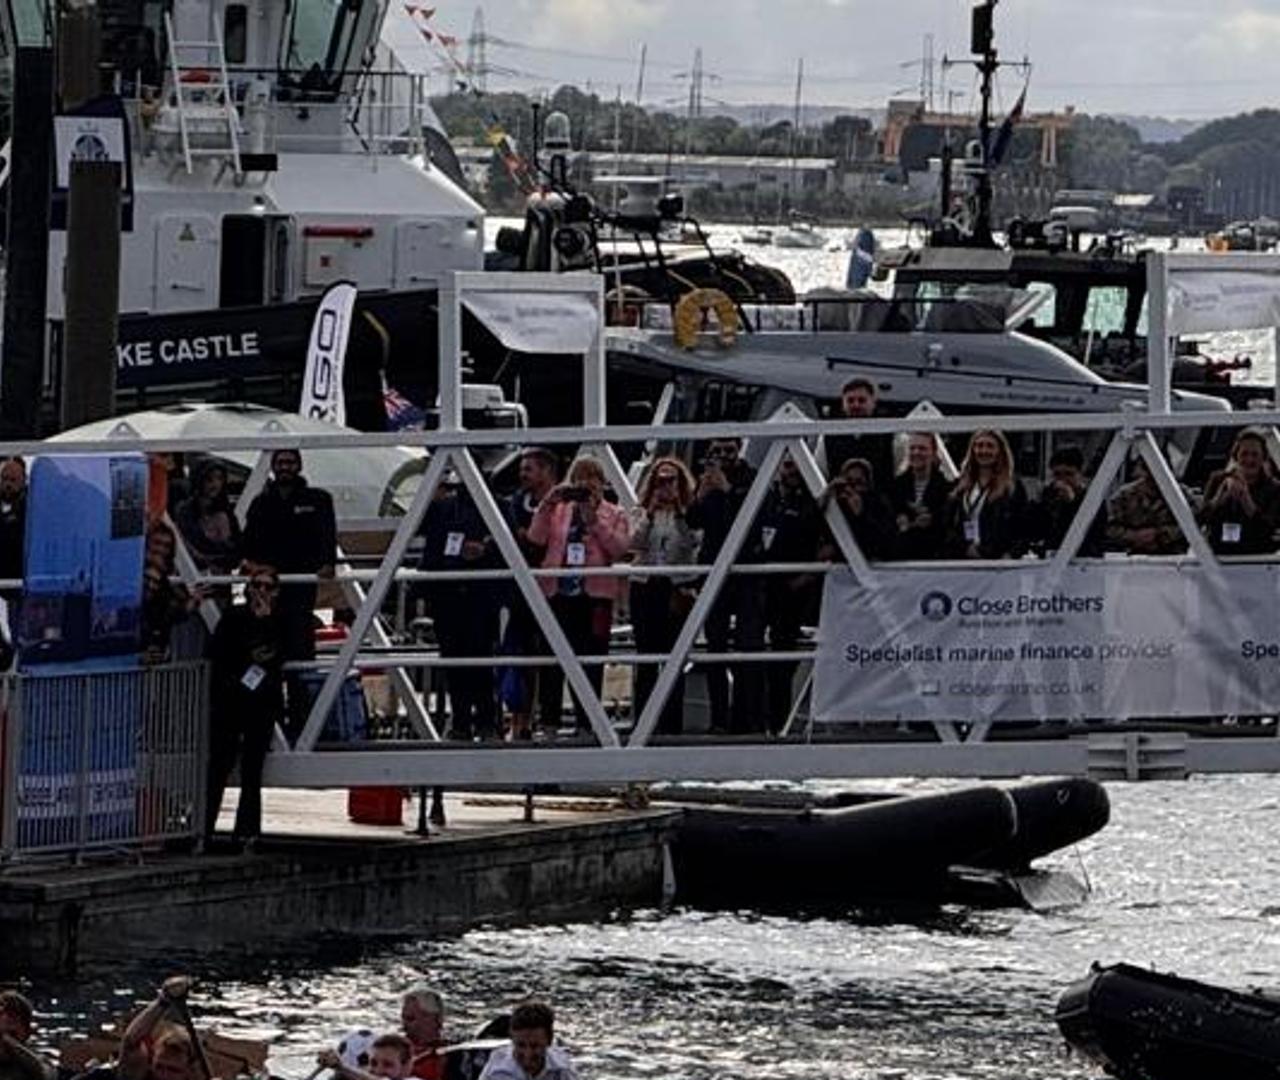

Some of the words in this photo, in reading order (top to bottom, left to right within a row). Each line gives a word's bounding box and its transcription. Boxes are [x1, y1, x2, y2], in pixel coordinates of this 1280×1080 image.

[159, 331, 260, 364] CASTLE
[958, 597, 1013, 616] Close
[1017, 593, 1104, 614] Brothers
[846, 644, 942, 667] Specialist
[949, 647, 1014, 661] marine
[1021, 644, 1093, 660] finance
